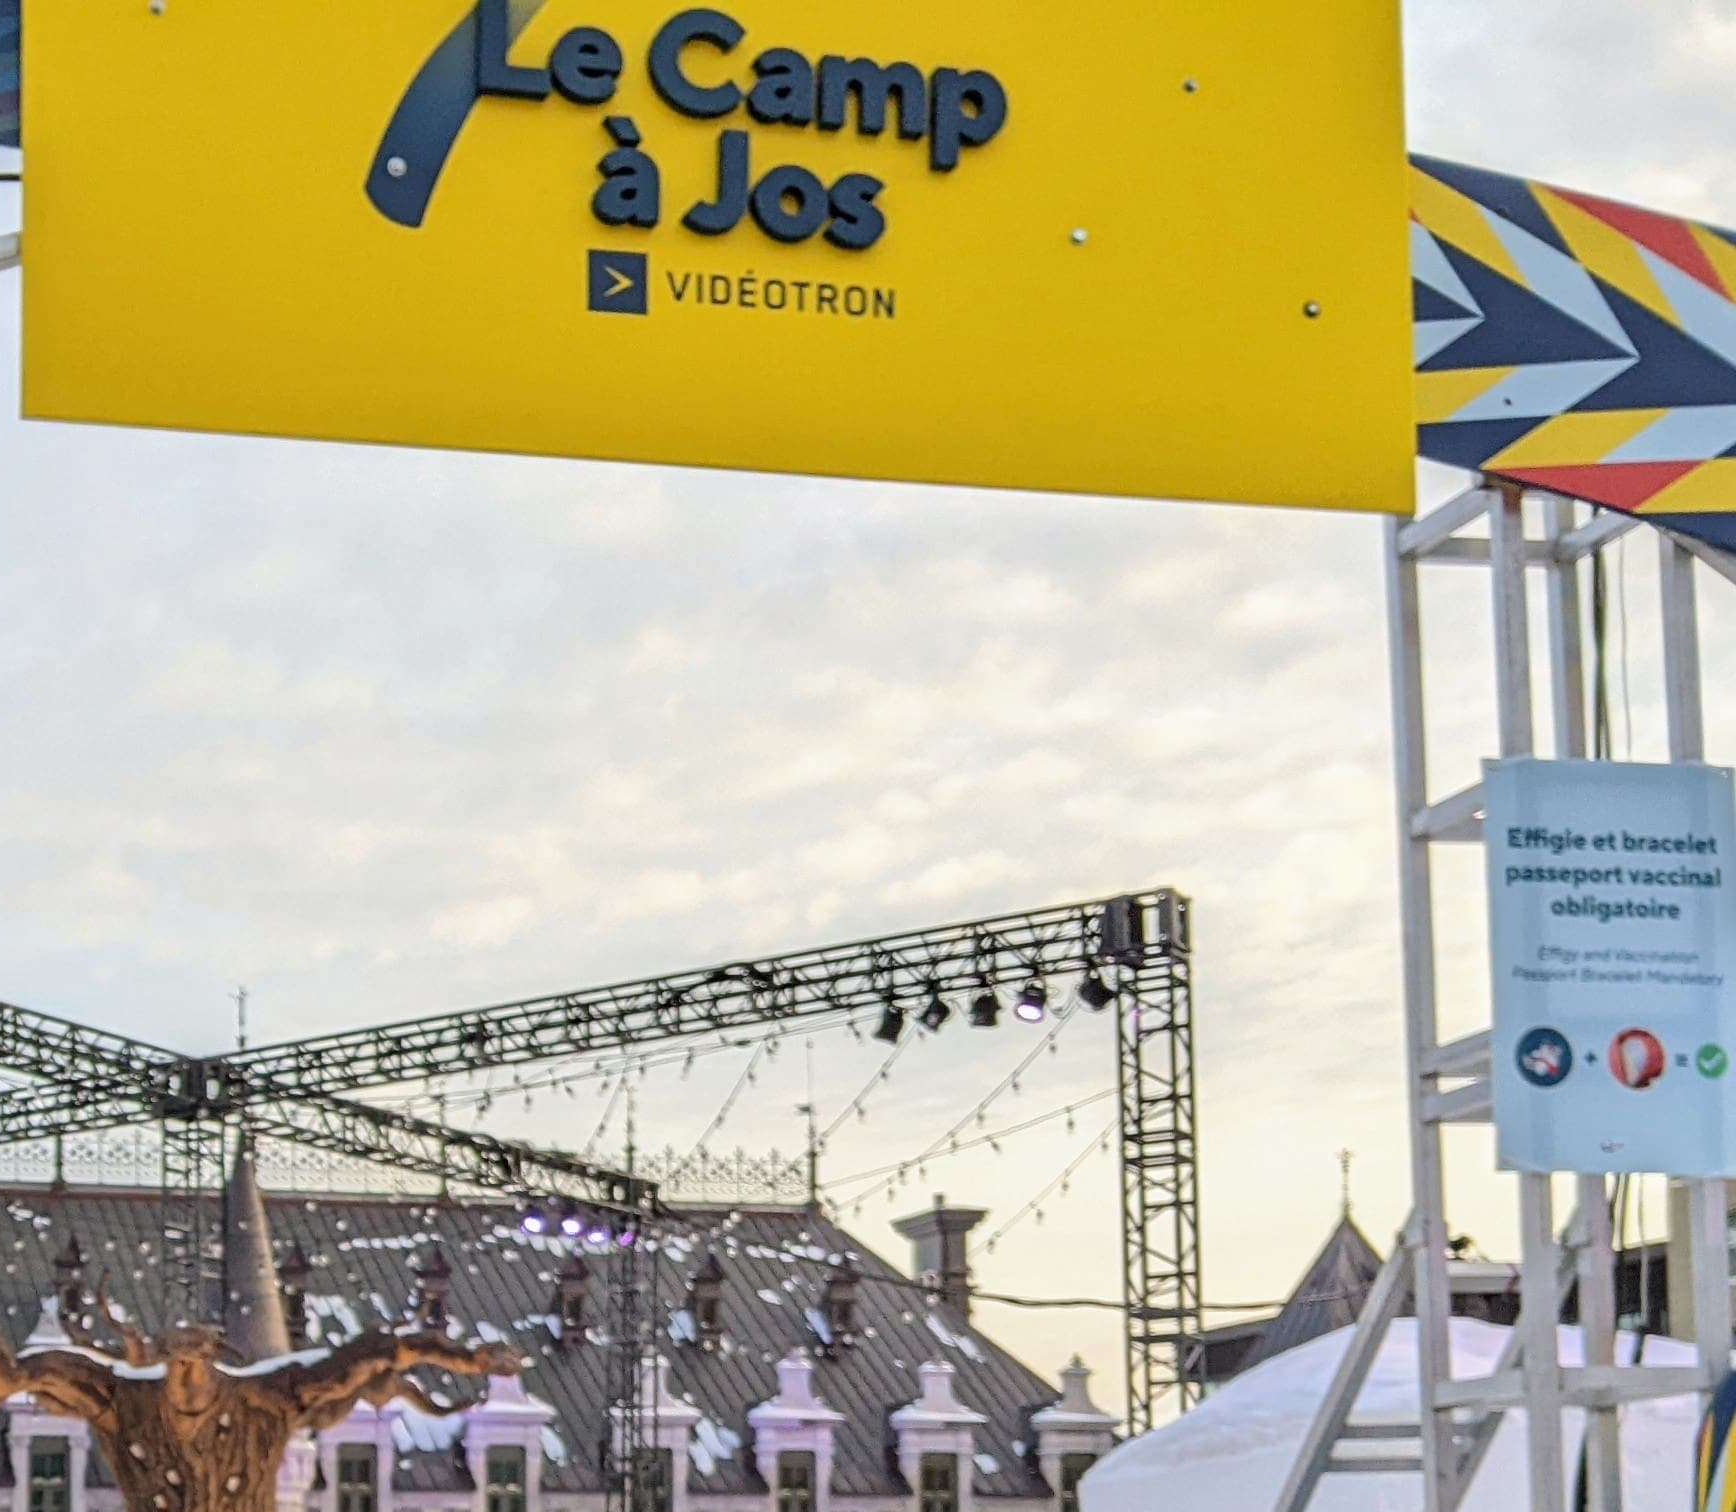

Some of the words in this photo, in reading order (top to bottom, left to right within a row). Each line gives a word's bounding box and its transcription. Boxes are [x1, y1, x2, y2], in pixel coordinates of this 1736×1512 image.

[476, 0, 623, 103] Le
[648, 9, 1007, 172] Camp
[591, 115, 660, 229] à
[681, 129, 885, 250] Jos
[666, 269, 896, 319] VIDÉOTRON
[1507, 827, 1587, 855] Effigie
[1592, 834, 1617, 851] et
[1622, 830, 1718, 855] bracelet
[1505, 864, 1623, 889] passeport
[1628, 866, 1721, 888] vaccinal
[1550, 895, 1681, 923] obligatoire
